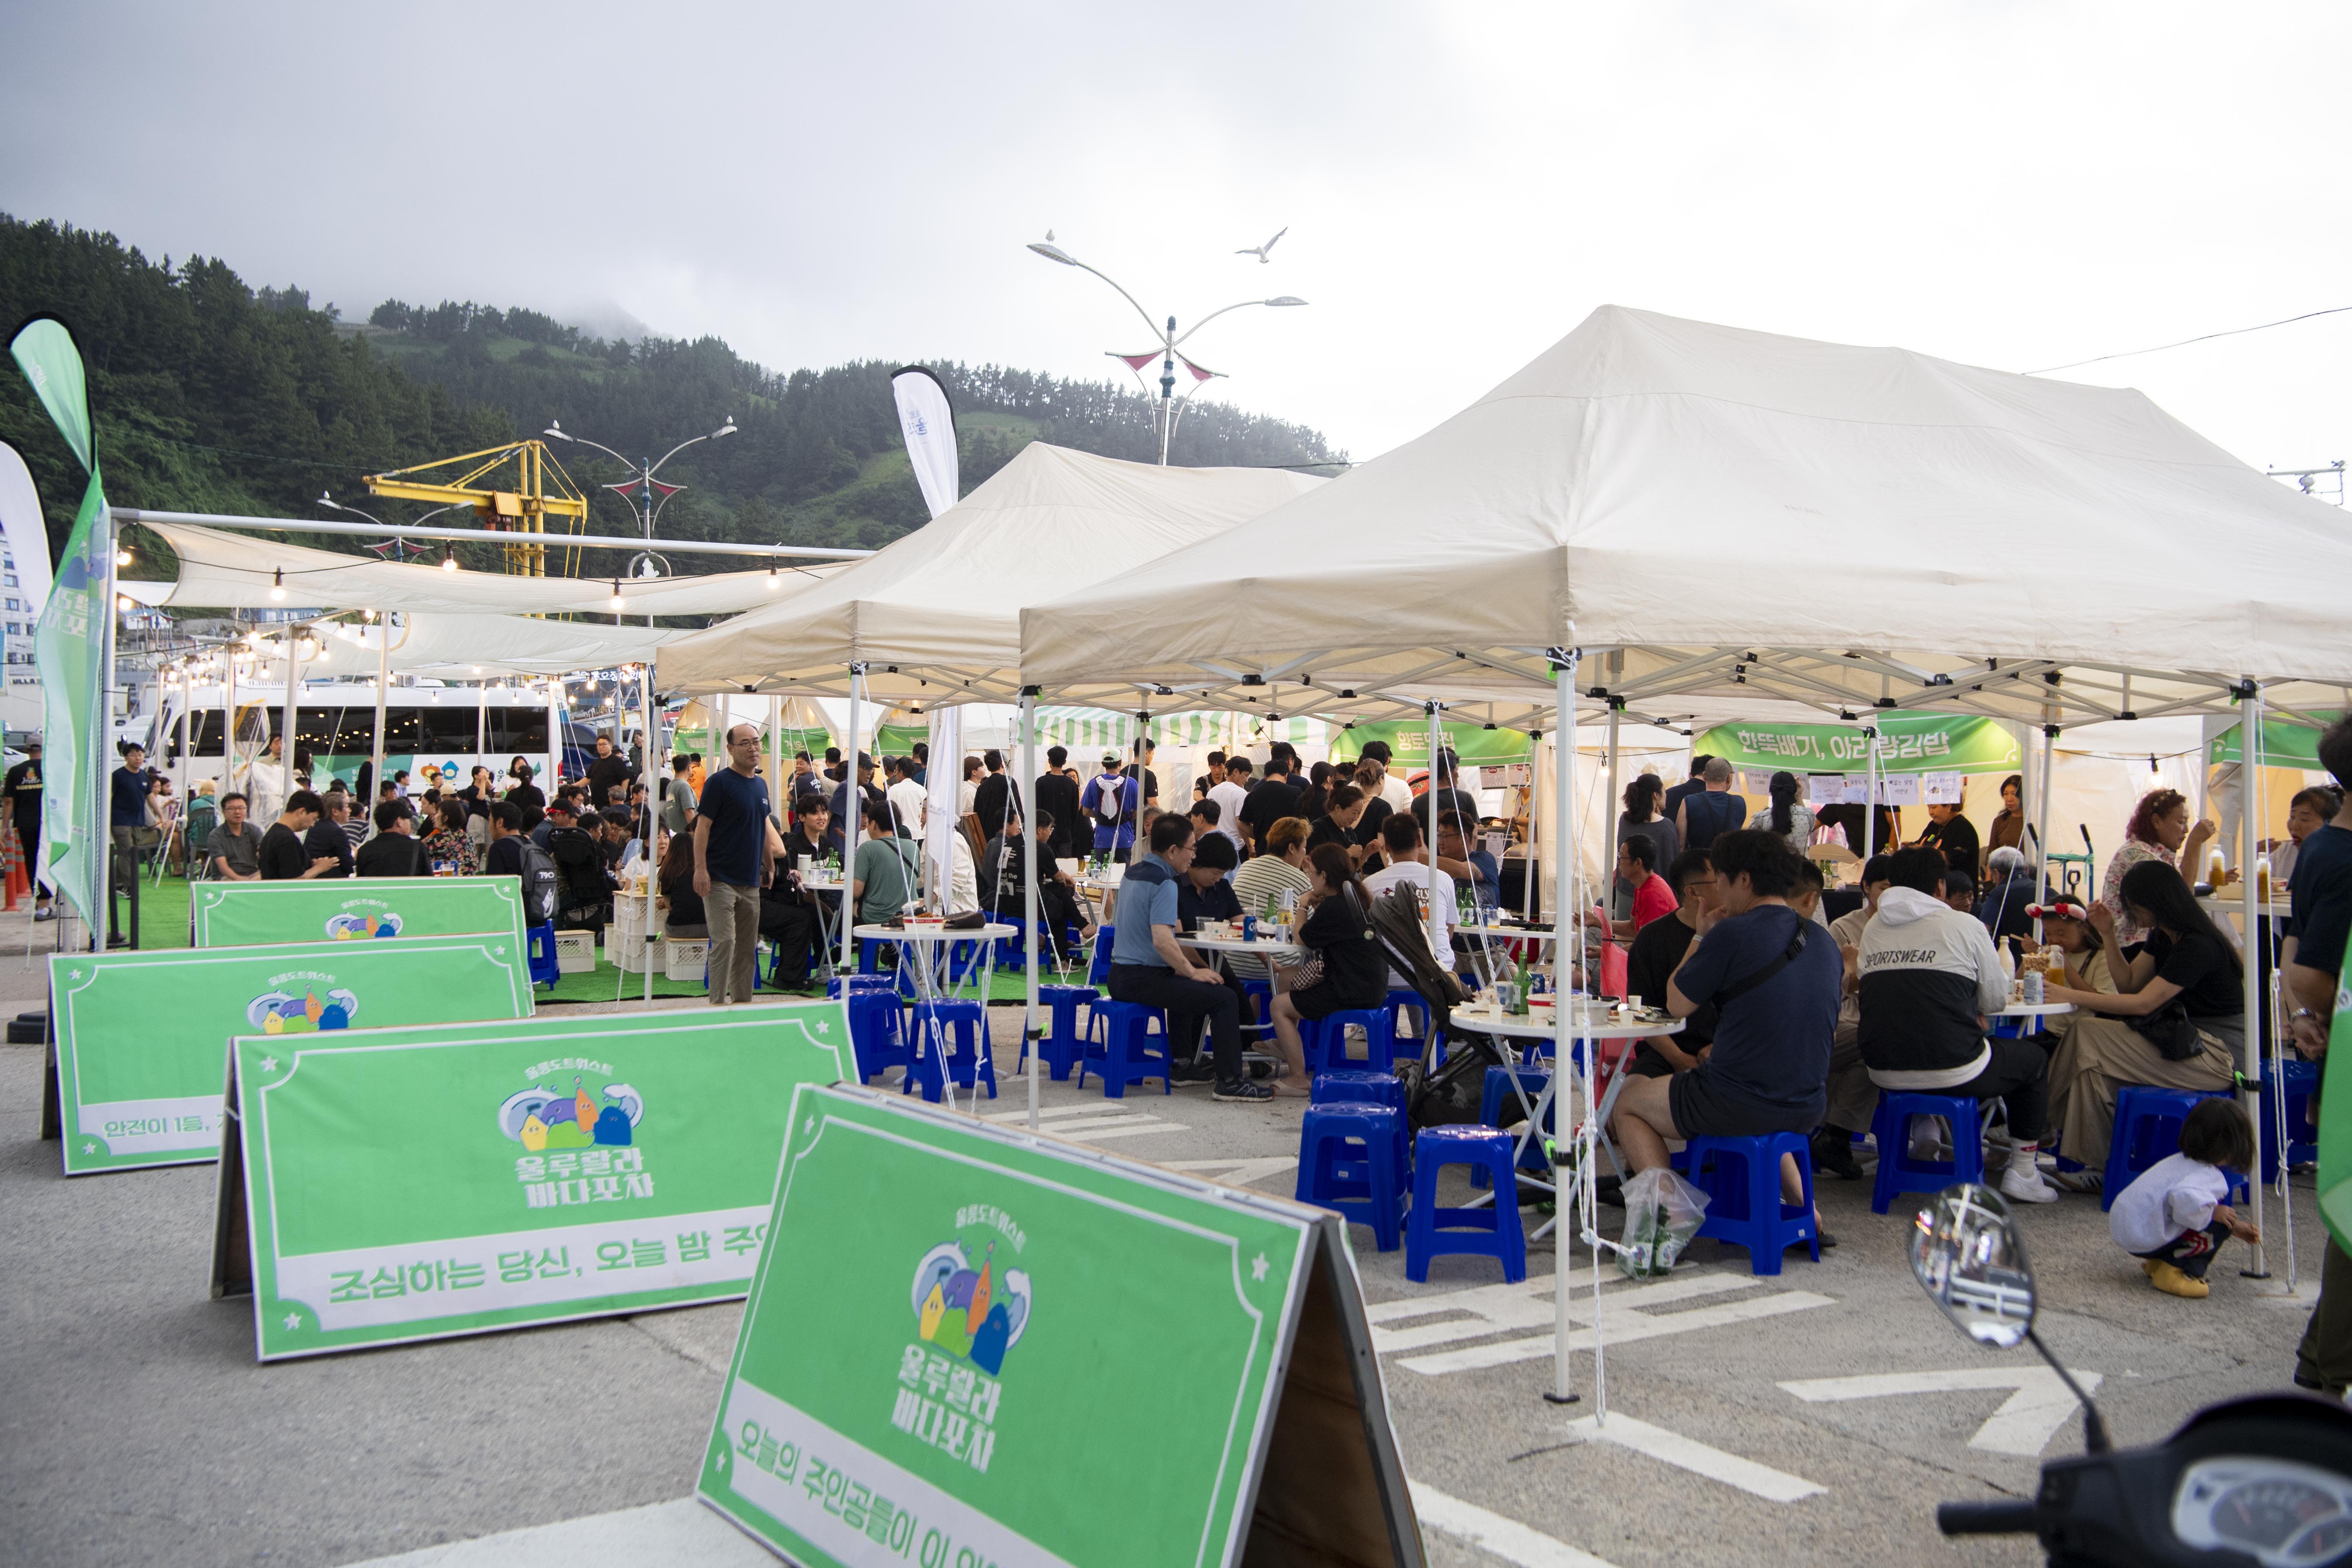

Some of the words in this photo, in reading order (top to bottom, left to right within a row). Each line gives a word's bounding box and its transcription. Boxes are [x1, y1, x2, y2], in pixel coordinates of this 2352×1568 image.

[1738, 730, 1825, 761] 한뚝배기,
[1865, 950, 1936, 968] SPORTSWEAR
[514, 1147, 644, 1182] 울루랄라
[524, 1173, 655, 1208] 바다포차
[329, 1259, 485, 1304] 조심하는
[497, 1246, 582, 1284] 당신,
[596, 1238, 667, 1272] 오늘
[677, 1231, 711, 1263] 밤
[898, 1343, 1002, 1426] 울루랄라
[891, 1386, 996, 1474] 바다포차
[736, 1418, 801, 1486] 오늘의
[802, 1455, 918, 1560] 주인공들이
